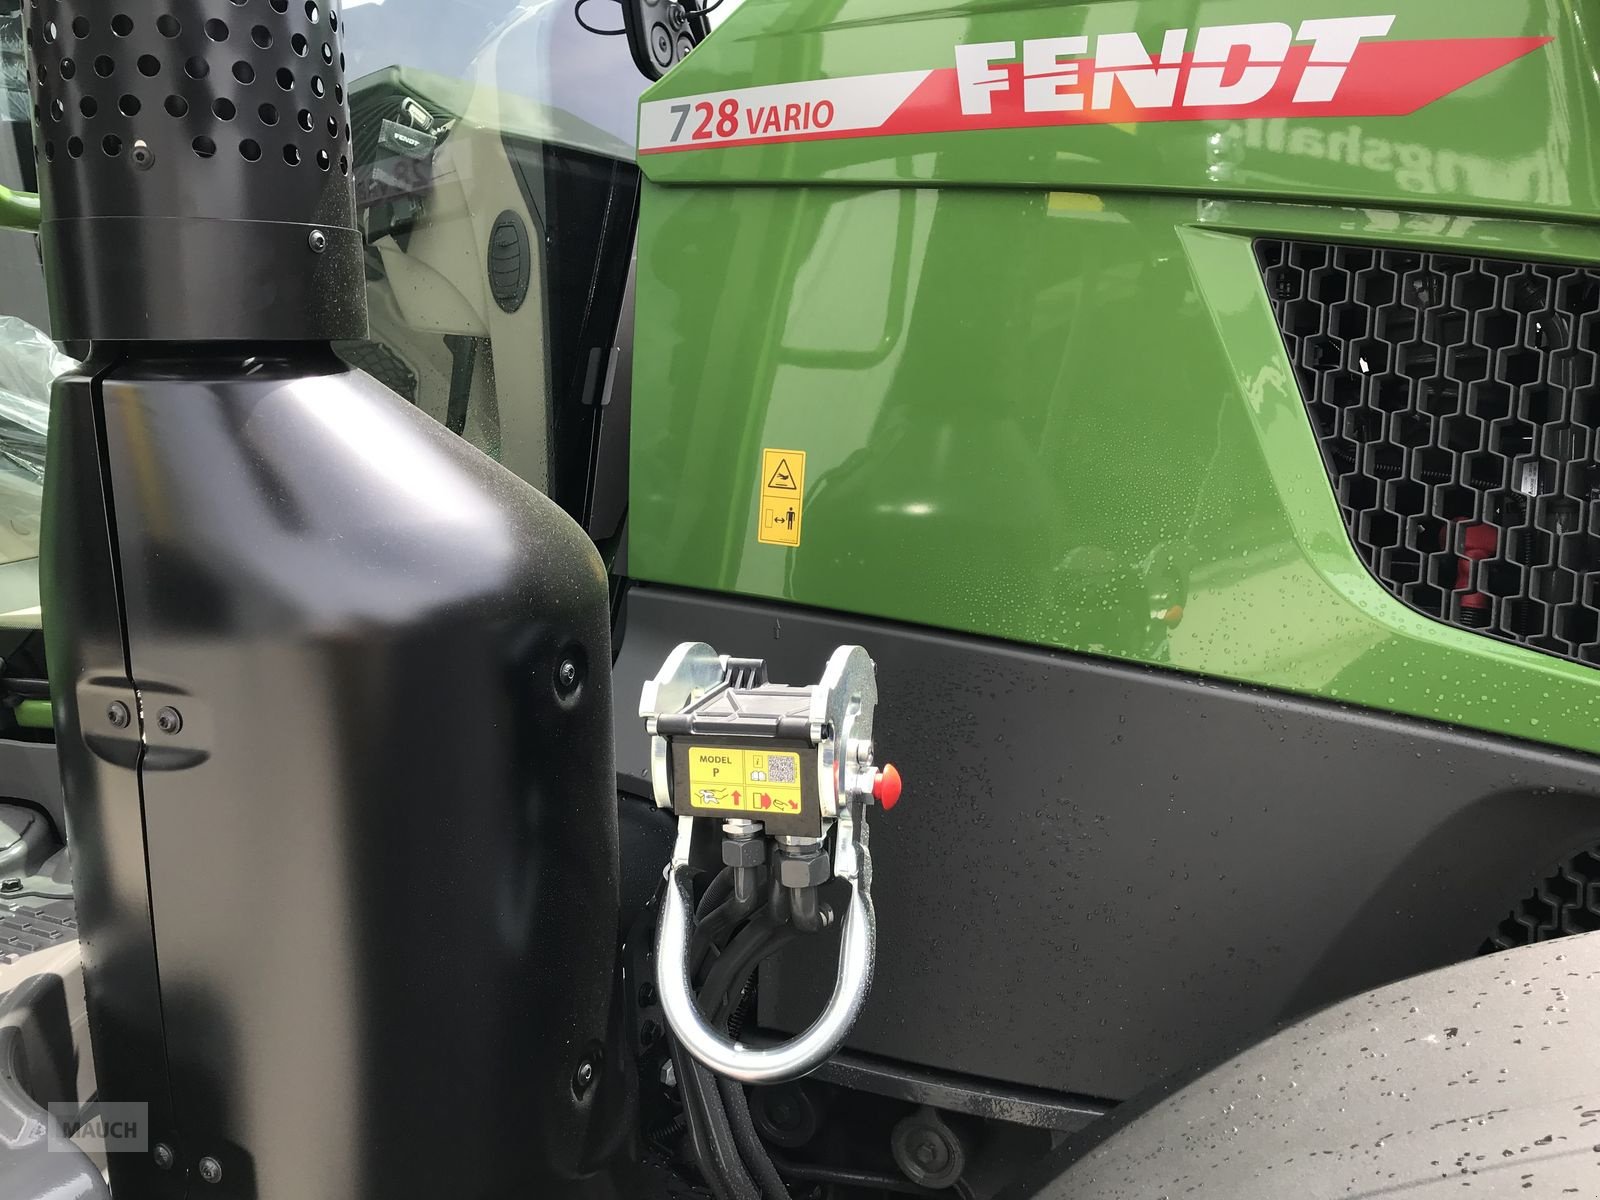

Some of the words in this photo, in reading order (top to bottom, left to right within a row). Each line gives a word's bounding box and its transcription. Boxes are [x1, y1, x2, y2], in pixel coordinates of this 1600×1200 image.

[954, 14, 1397, 116] FENDT
[669, 98, 740, 142] 728
[746, 100, 835, 134] VARIO
[394, 133, 421, 147] FENDT
[699, 755, 733, 765] MODEL
[712, 768, 721, 778] P
